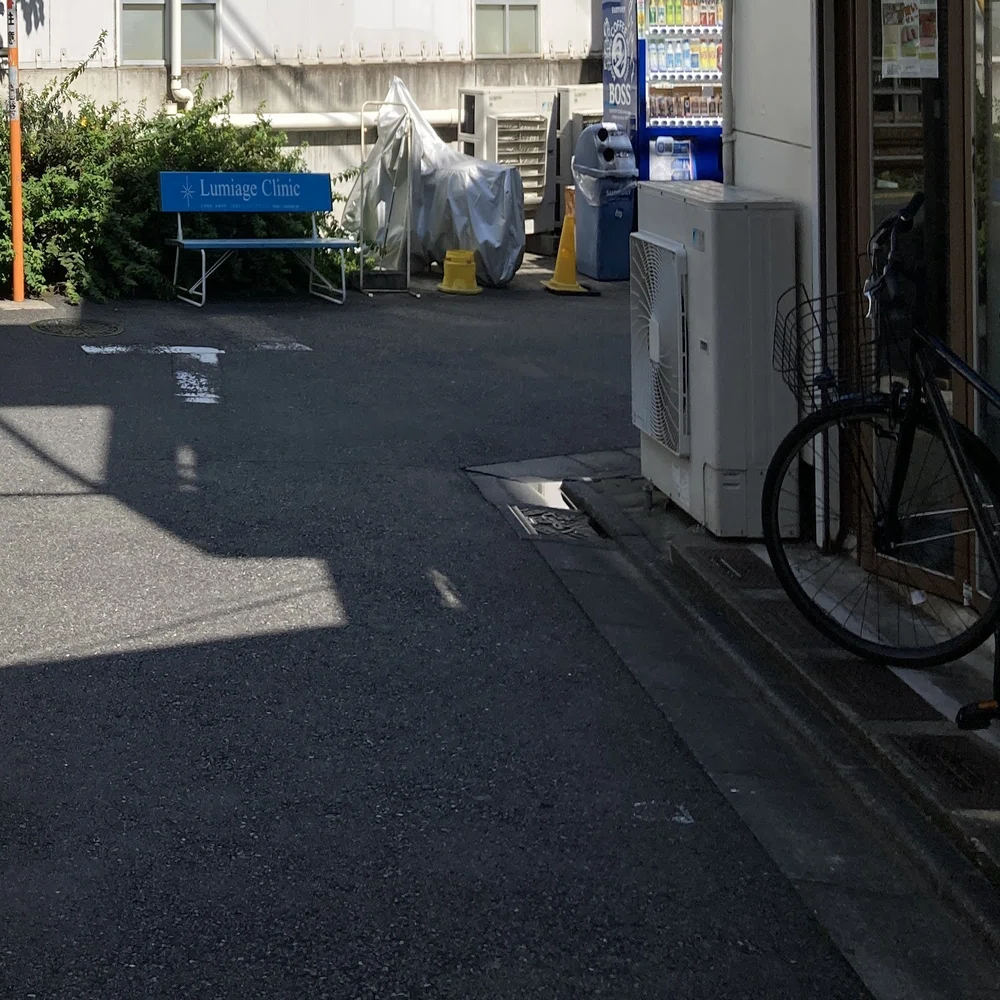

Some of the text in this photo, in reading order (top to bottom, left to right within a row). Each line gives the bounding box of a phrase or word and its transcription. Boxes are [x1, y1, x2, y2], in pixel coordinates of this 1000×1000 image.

[609, 83, 631, 106] BOSS
[200, 178, 300, 201] Lumiage Clinic
